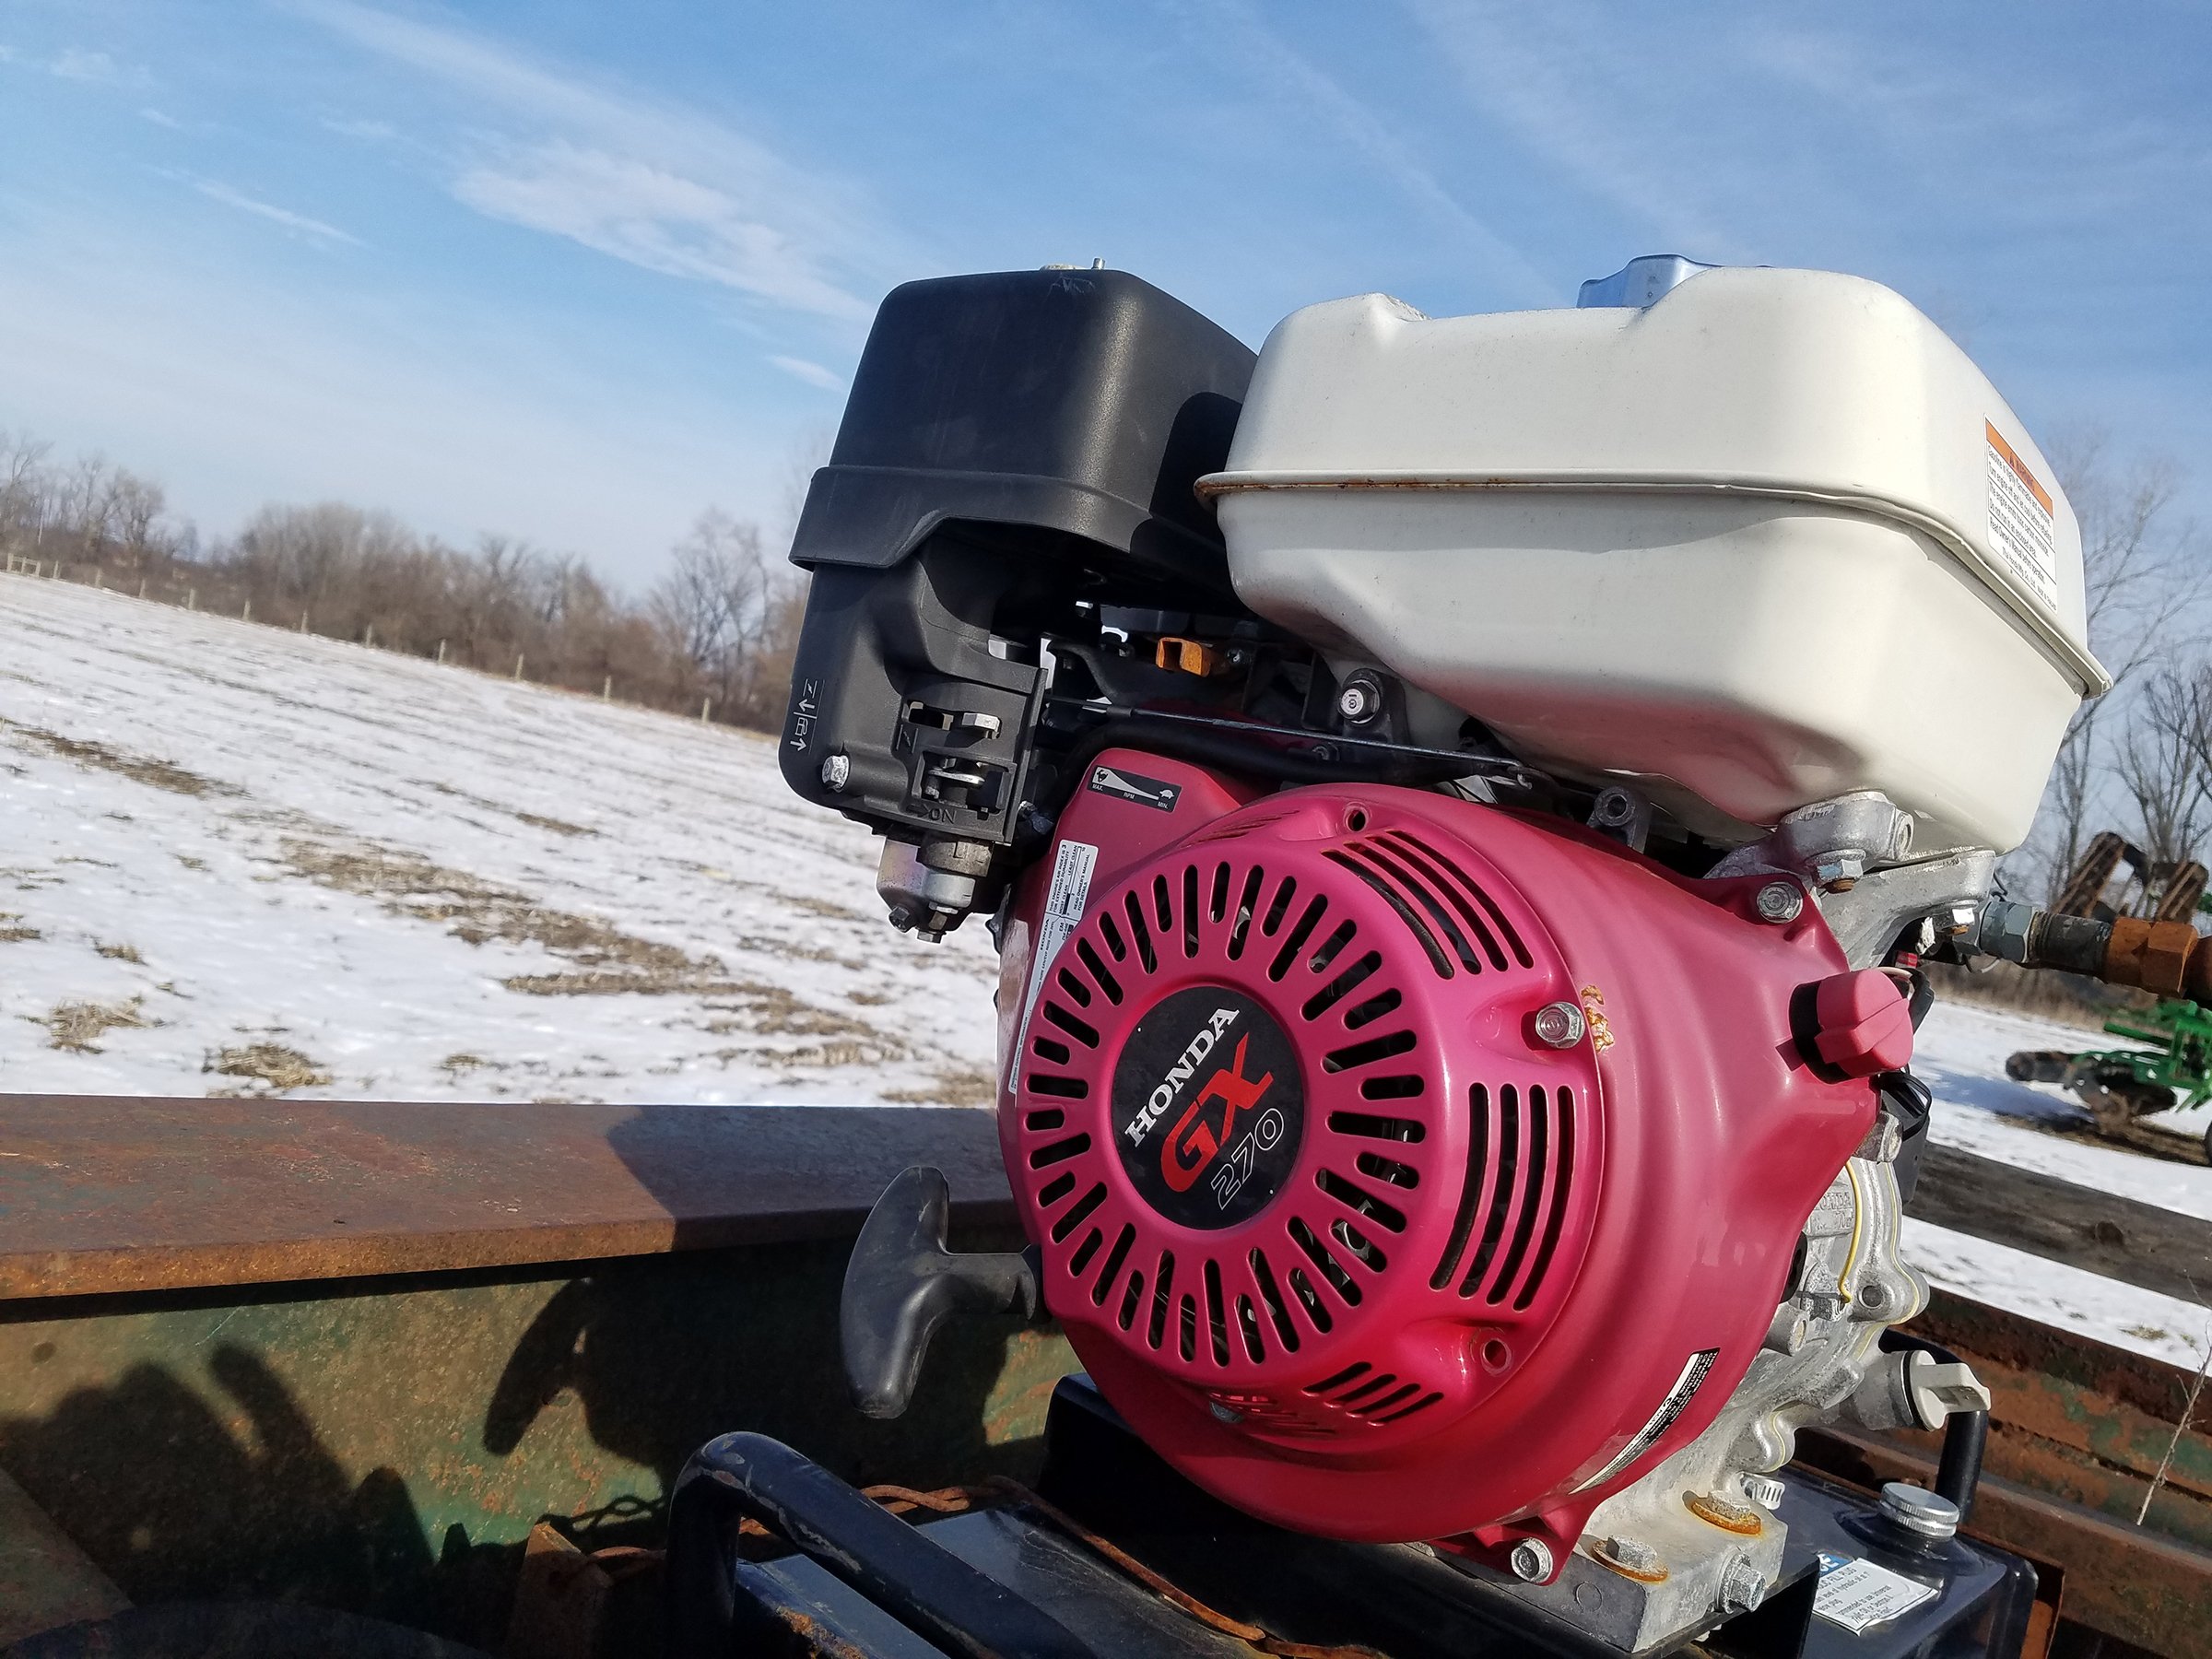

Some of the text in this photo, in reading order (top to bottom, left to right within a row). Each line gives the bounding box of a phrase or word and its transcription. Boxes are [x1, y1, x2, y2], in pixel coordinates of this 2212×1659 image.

[1988, 444, 2002, 470] Gasoline
[2016, 477, 2030, 504] flammable
[2015, 525, 2029, 549] enclosed
[929, 807, 958, 825] ON
[1081, 853, 1089, 874] MANUAL
[1040, 918, 1049, 950] HONDA
[1124, 1007, 1240, 1147] HONDA
[1160, 1032, 1274, 1192] GX
[1210, 1108, 1284, 1210] 270
